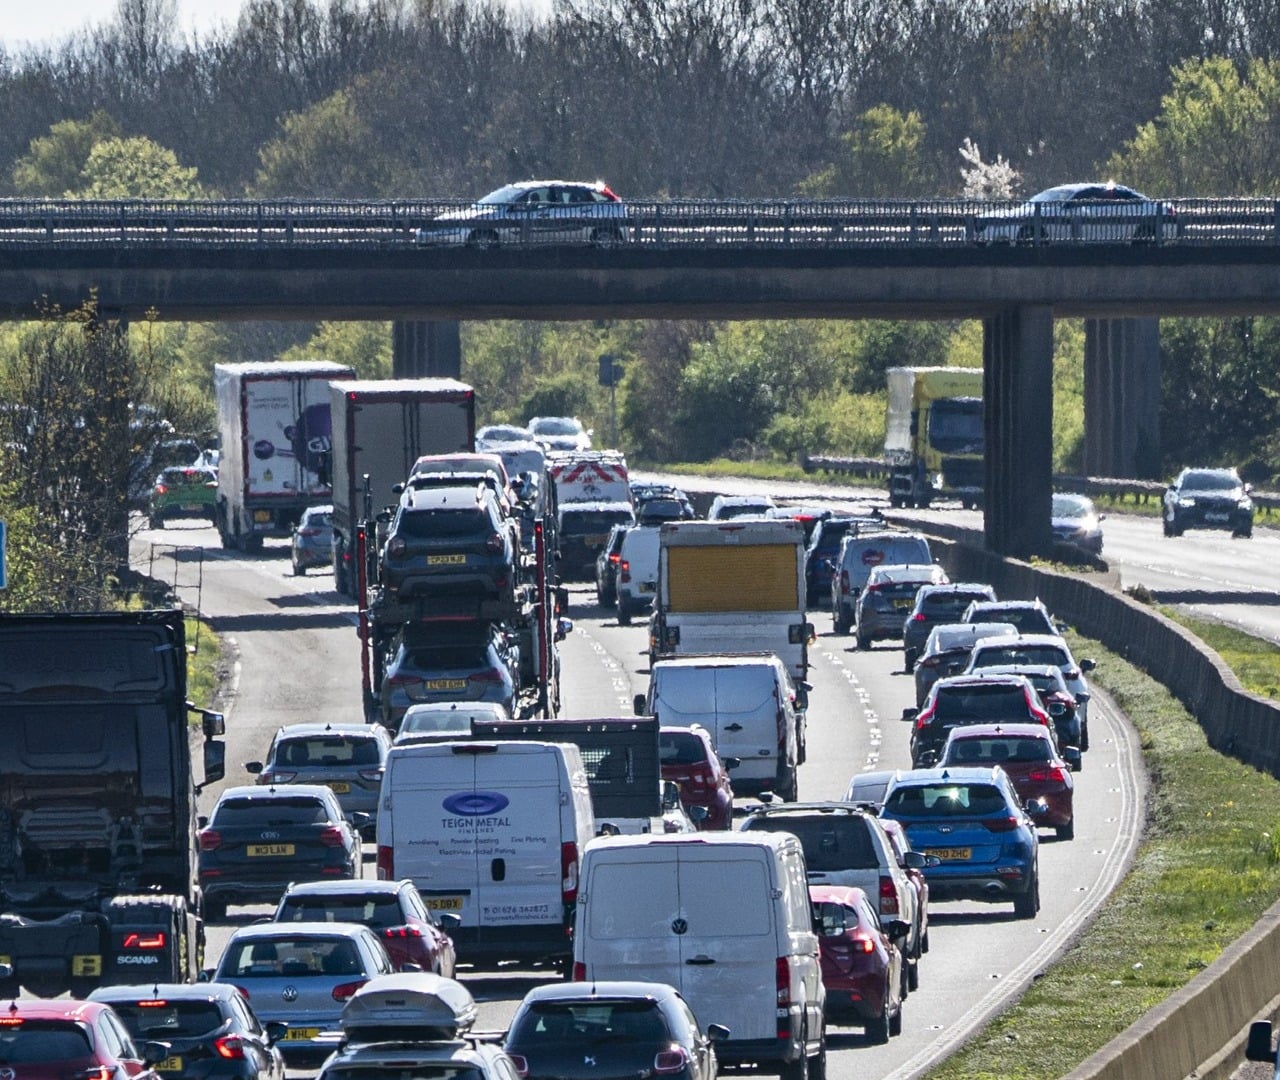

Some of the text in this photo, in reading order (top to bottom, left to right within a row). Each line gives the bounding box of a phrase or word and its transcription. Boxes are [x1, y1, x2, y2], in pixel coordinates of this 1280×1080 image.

[441, 817, 511, 828] TEIGN METAL
[117, 955, 158, 965] SCANIA
